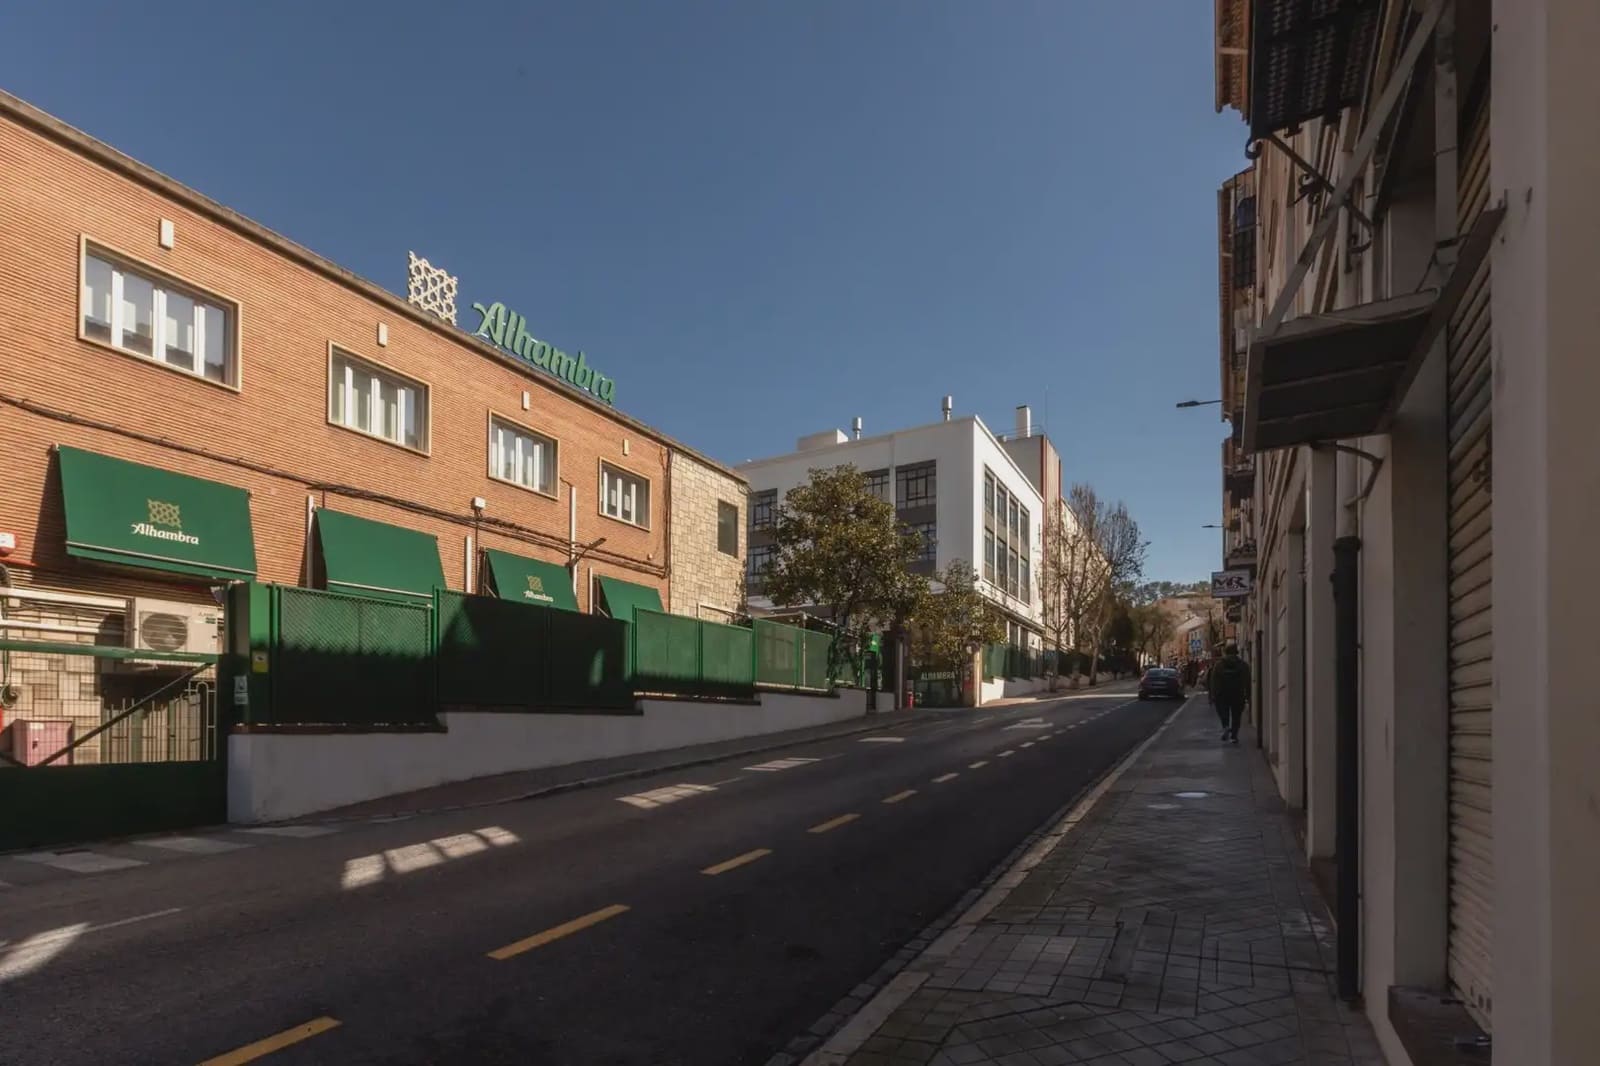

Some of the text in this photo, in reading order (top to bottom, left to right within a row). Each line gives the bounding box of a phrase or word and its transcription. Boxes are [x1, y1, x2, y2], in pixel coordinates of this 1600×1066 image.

[472, 302, 615, 403] Alhambra
[131, 523, 199, 544] Alhambra
[523, 590, 554, 602] Alhambra
[921, 671, 956, 681] ALHAMBRA
